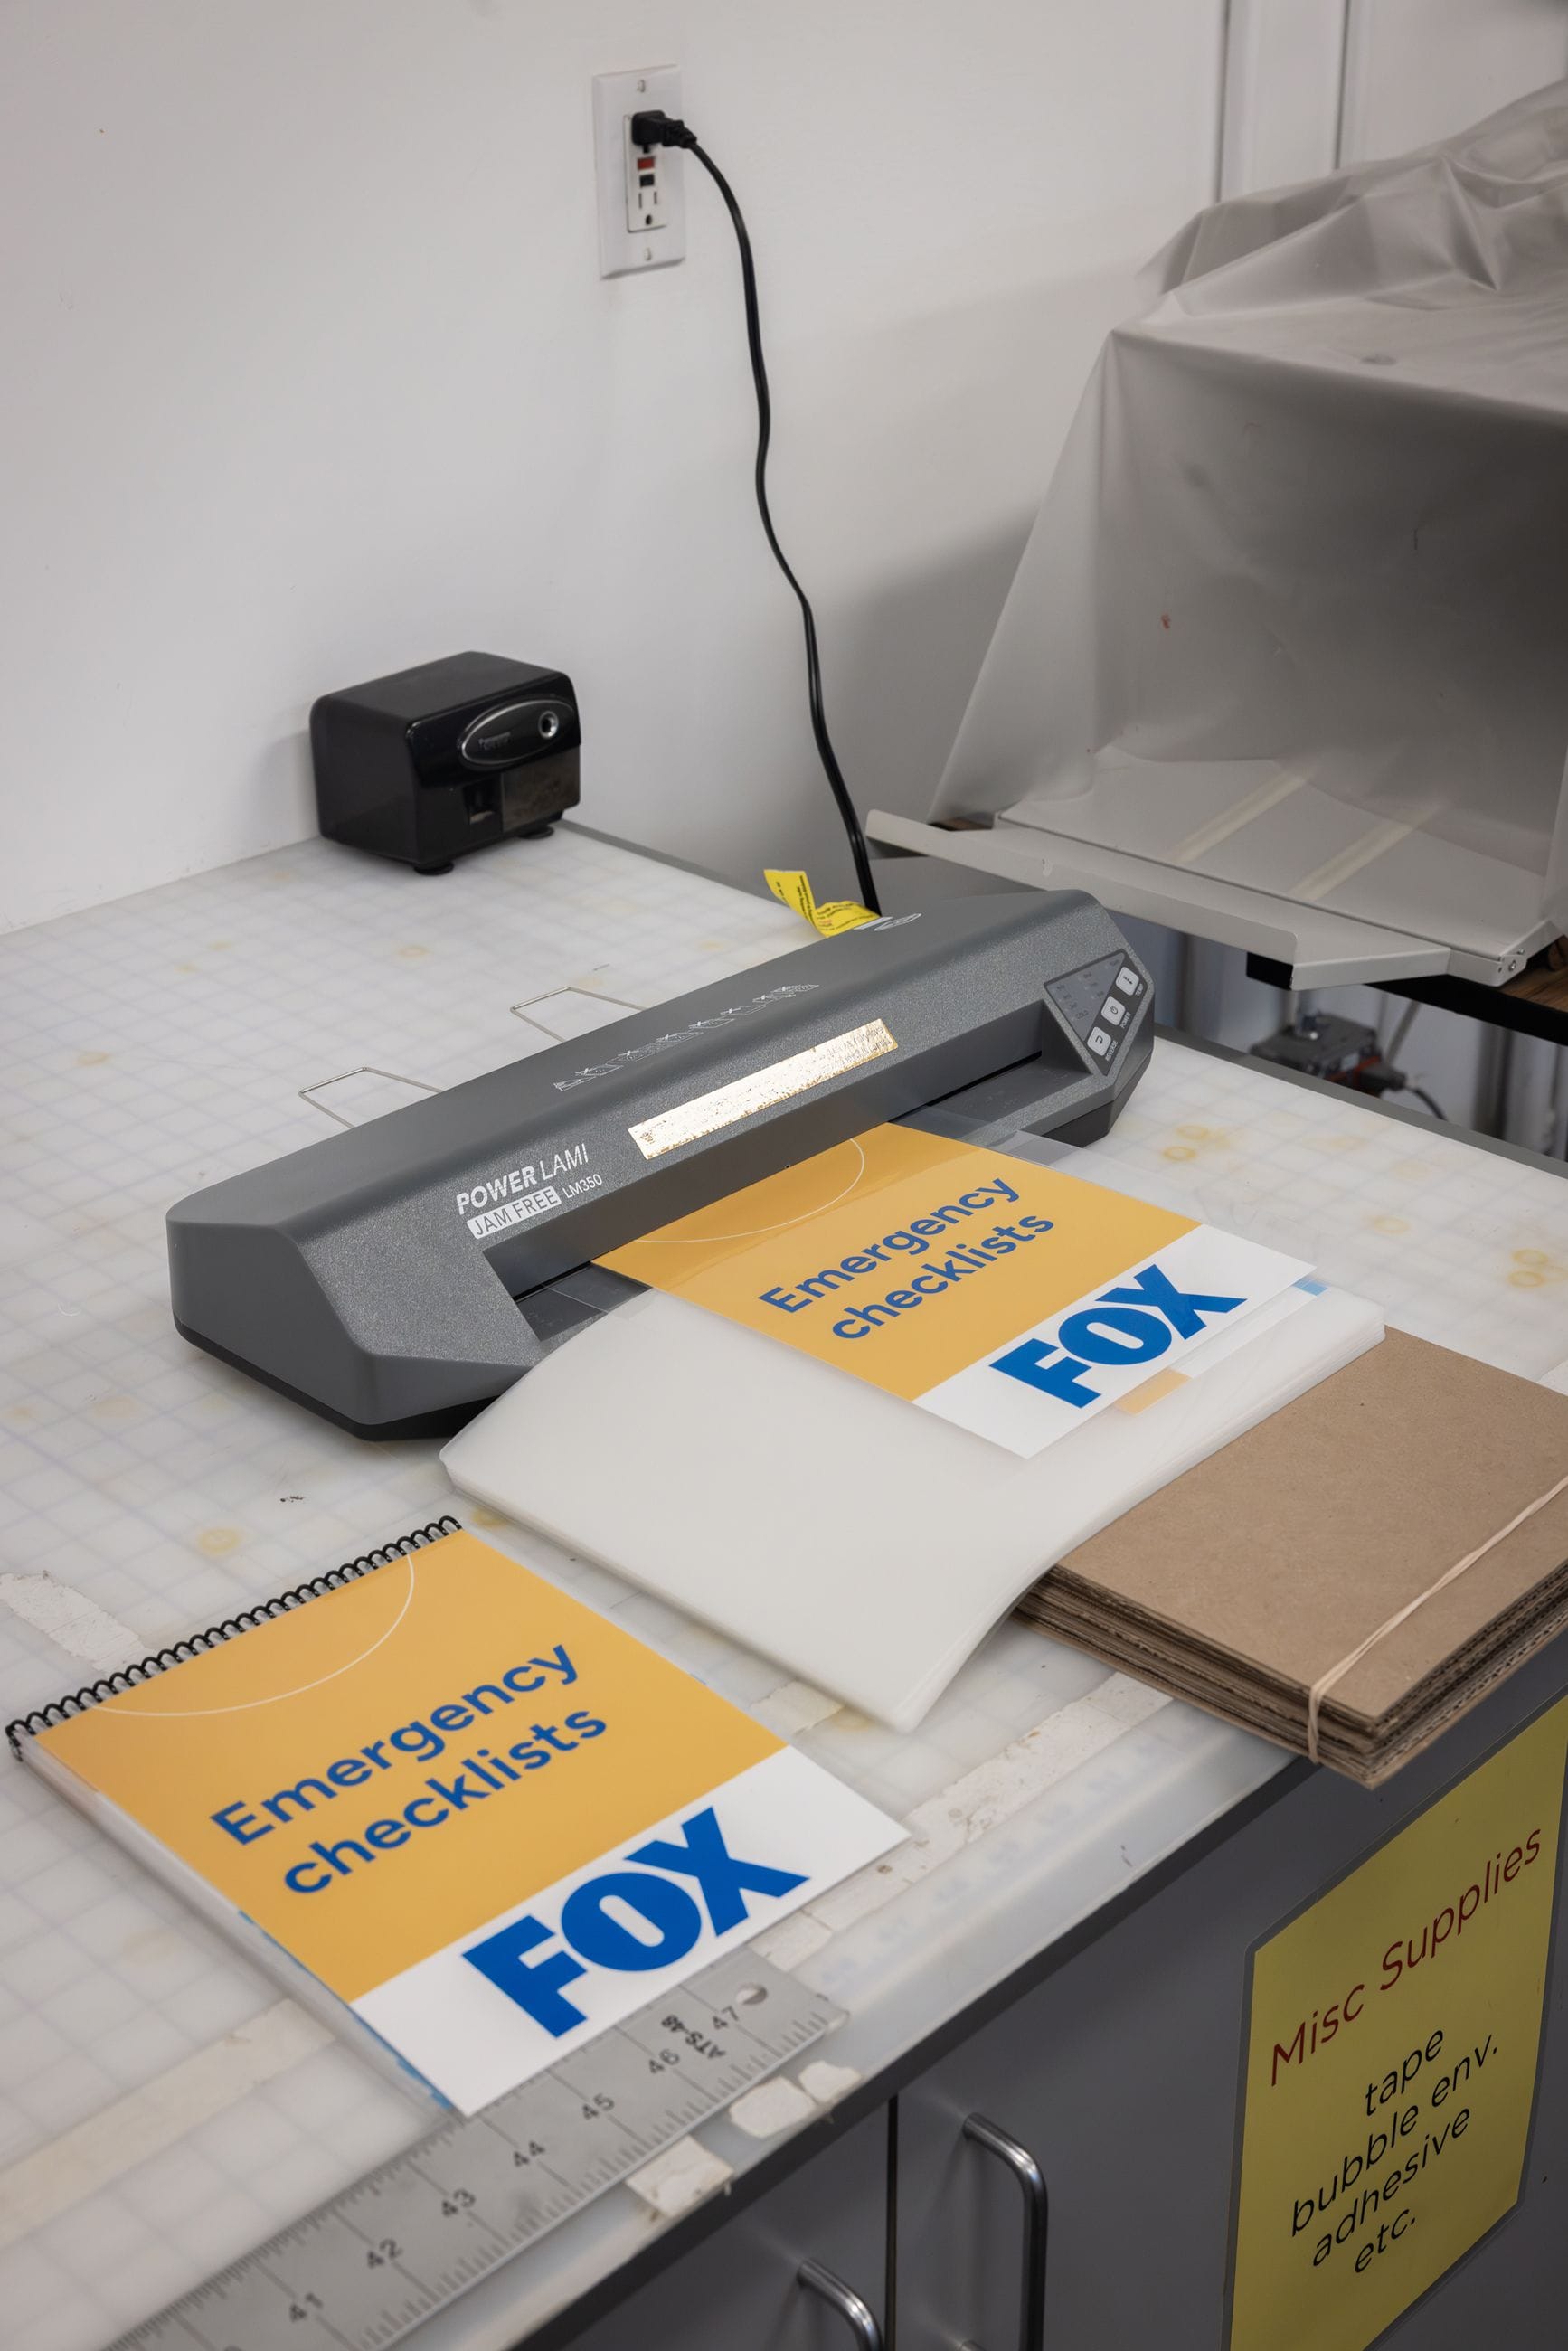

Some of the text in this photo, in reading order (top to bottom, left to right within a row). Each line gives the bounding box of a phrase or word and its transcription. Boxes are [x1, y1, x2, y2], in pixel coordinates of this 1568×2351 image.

[1119, 1011, 1131, 1029] POWER
[456, 1143, 589, 1215] POWER LAMI
[474, 1174, 603, 1235] JAM FREE LM350
[758, 1177, 1021, 1314] Emergency
[832, 1212, 1055, 1339] checklists
[988, 1264, 1247, 1409] FOX
[210, 1643, 580, 1846] Emergency
[283, 1710, 607, 1894] checklists
[460, 1806, 811, 2038] FOX
[1271, 1828, 1542, 2087] Misc Supplies
[1291, 2034, 1497, 2237] bubble env.
[1365, 2029, 1443, 2116] tape
[289, 2005, 739, 2322] 41 42 43 44 45 46 47
[1313, 2108, 1469, 2267] adhesive
[1355, 2208, 1416, 2273] etc.
